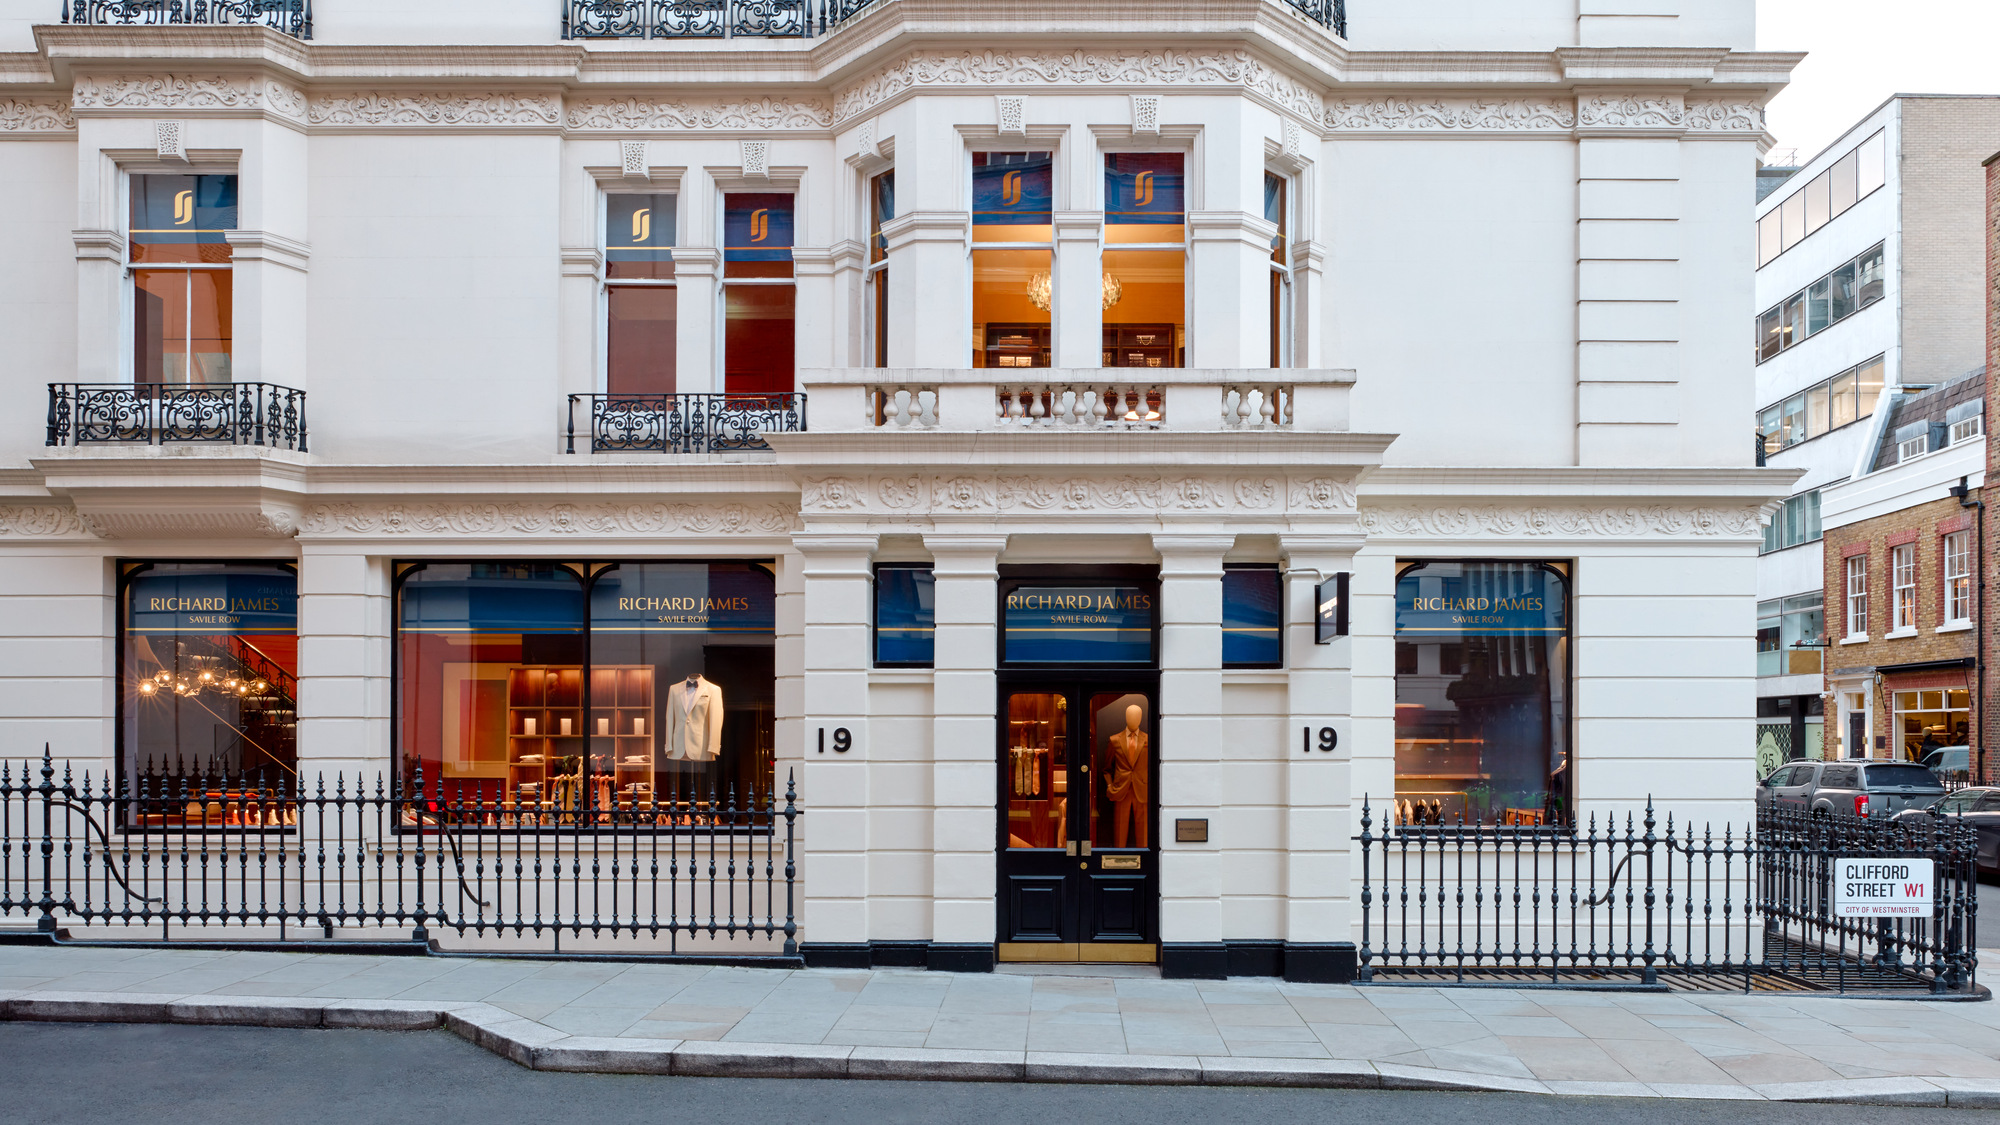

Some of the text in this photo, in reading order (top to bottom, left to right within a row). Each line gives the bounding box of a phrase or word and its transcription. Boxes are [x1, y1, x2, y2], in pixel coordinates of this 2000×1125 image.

[150, 597, 280, 614] RICHARD JAMES
[619, 597, 749, 613] RICHARD JAMES
[1007, 595, 1151, 612] RICHARD JAMES
[1413, 597, 1543, 613] RICHARD JAMES
[189, 615, 241, 624] SAVILE ROW
[658, 615, 710, 624] SAVILE ROW
[1050, 615, 1108, 624] SAVILE ROW
[1452, 615, 1504, 624] SAVILE ROW
[818, 727, 852, 753] 19
[1304, 726, 1337, 752] 19
[1846, 865, 1909, 880] CLIFFORD
[1846, 883, 1924, 898] STREET W1
[1845, 906, 1920, 914] CITY OF WESTMINSTER
